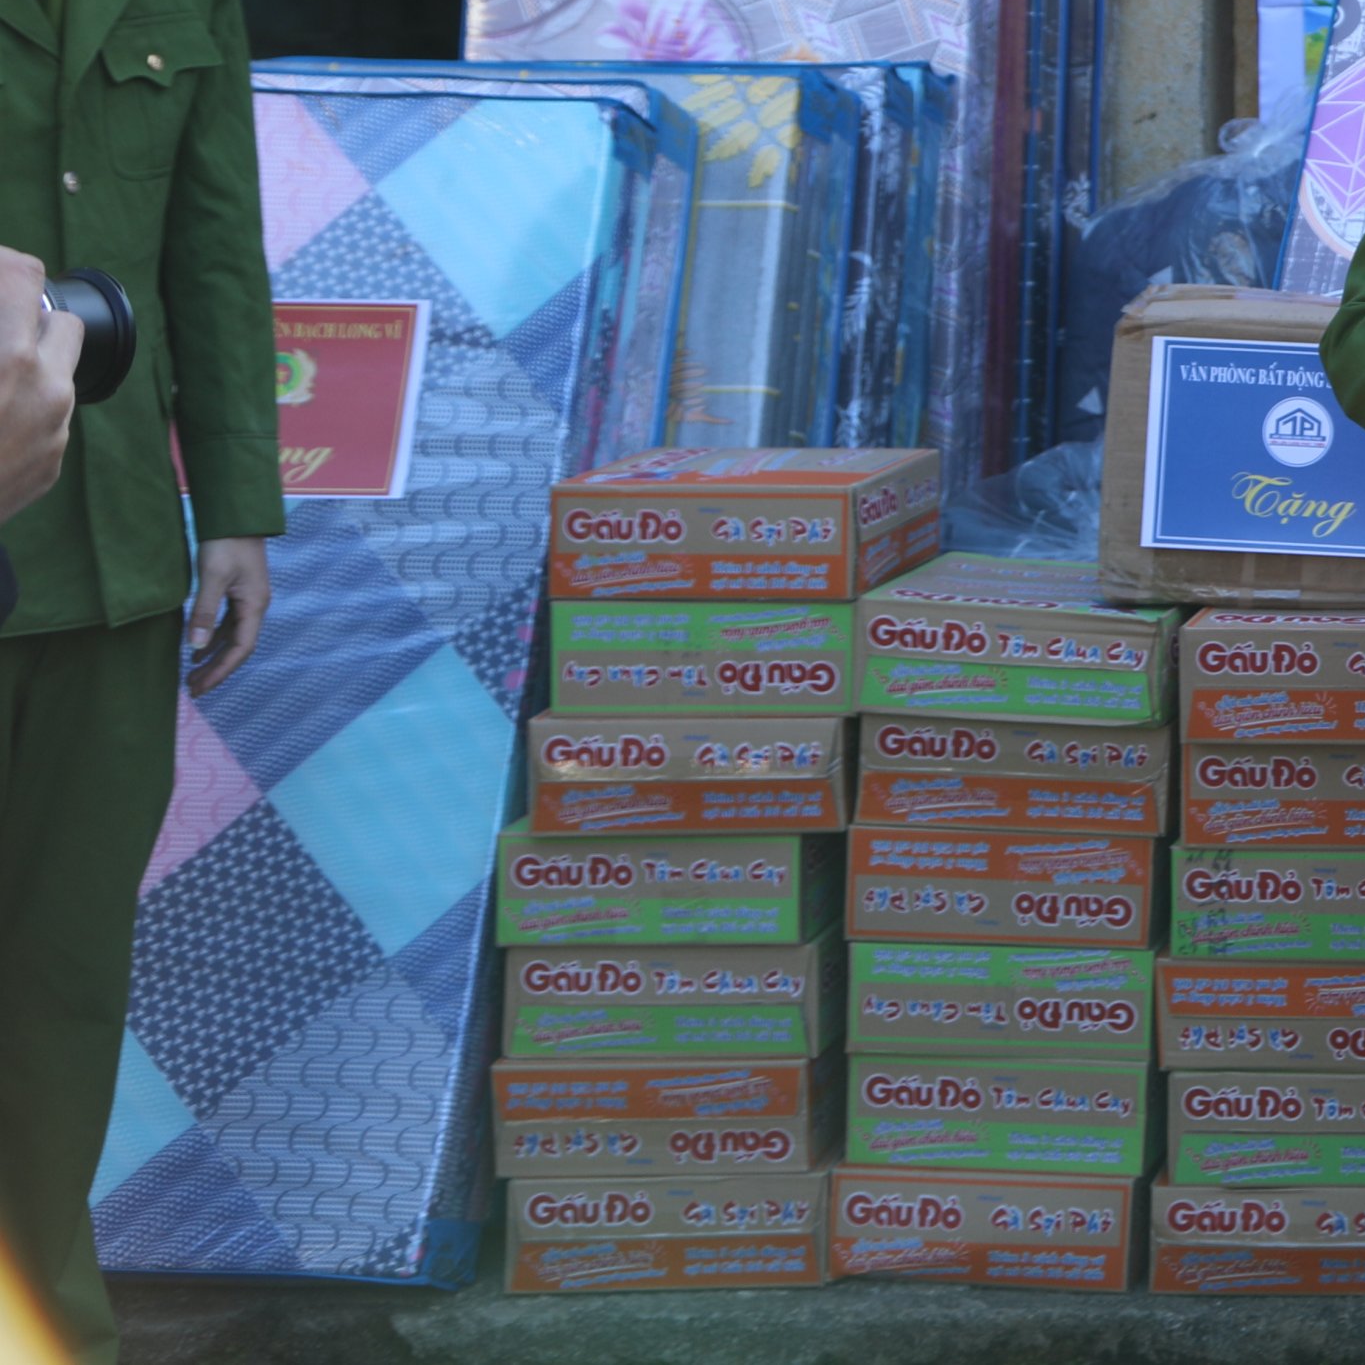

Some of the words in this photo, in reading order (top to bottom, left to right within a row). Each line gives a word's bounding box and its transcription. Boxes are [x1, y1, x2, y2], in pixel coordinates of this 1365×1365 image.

[1180, 362, 1208, 382] VĂN
[1209, 363, 1255, 385] PHÒNG
[1258, 362, 1284, 386] BẤT
[1287, 367, 1324, 390] ĐỘNG
[1231, 472, 1356, 538] Tặng
